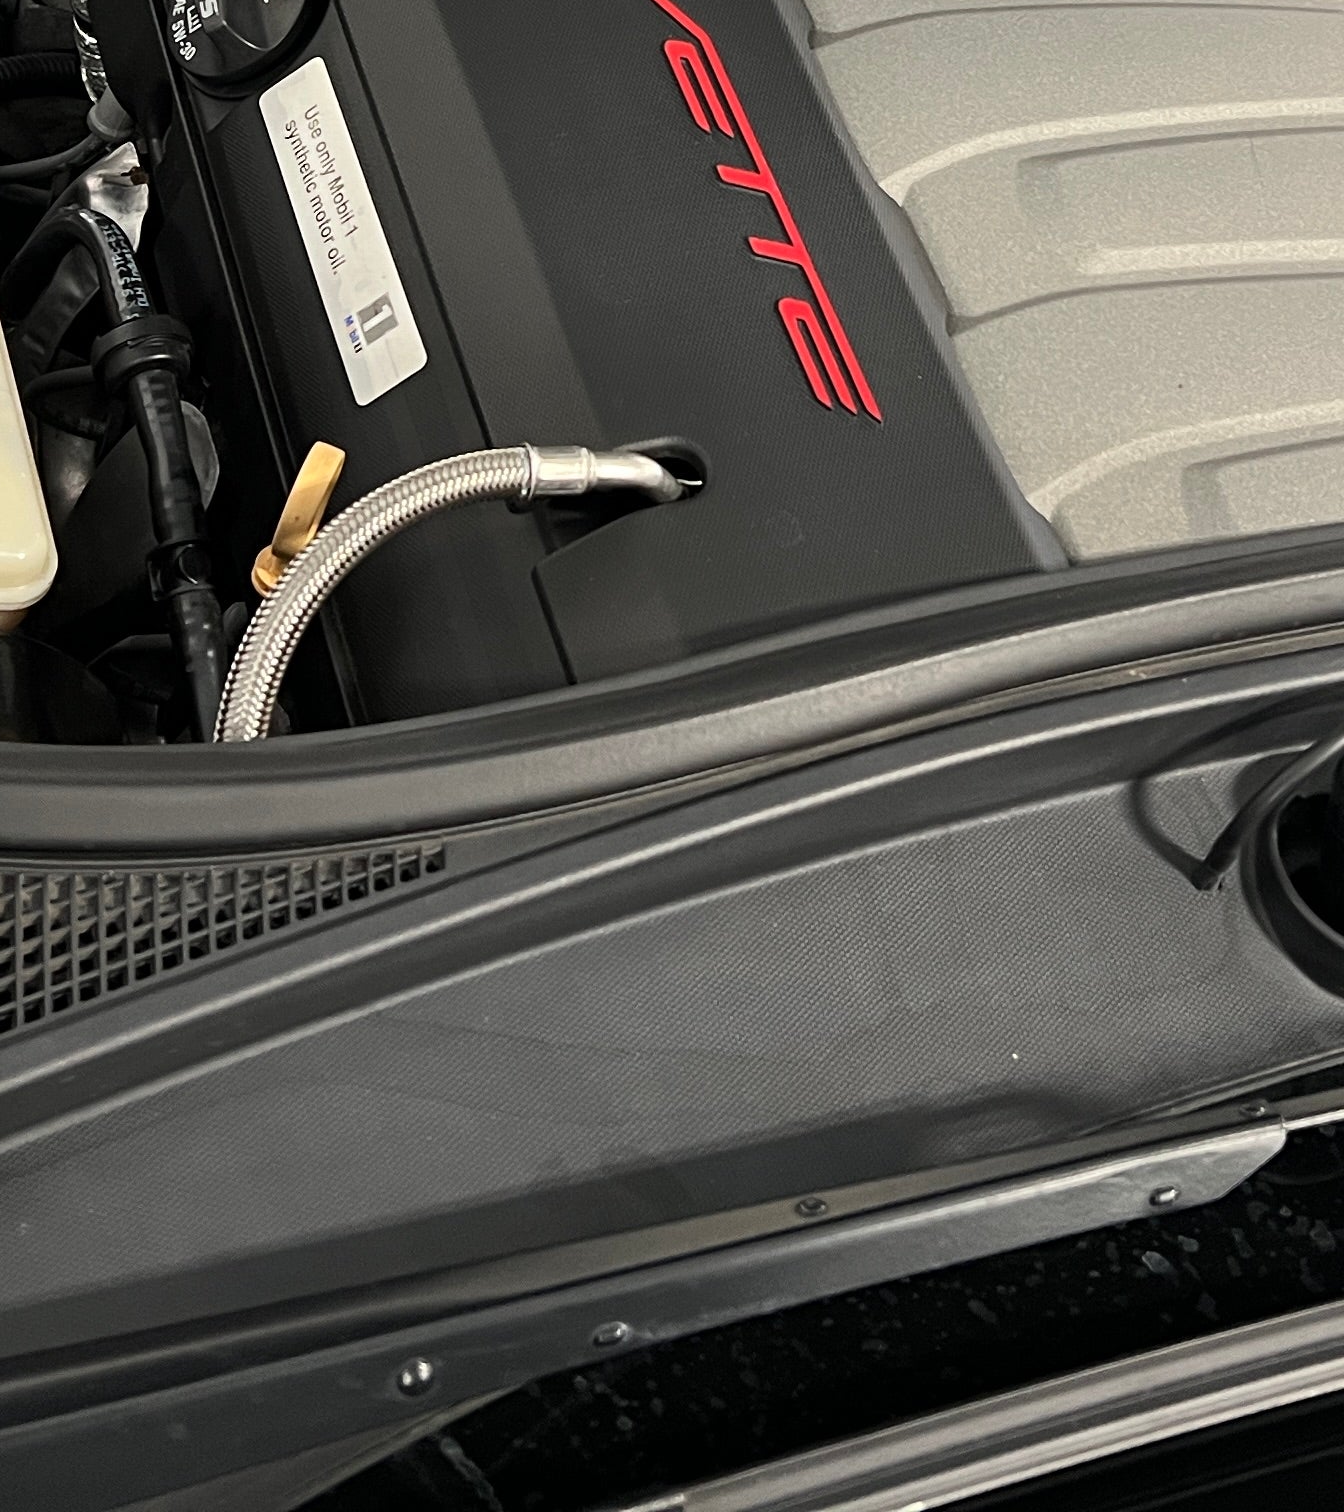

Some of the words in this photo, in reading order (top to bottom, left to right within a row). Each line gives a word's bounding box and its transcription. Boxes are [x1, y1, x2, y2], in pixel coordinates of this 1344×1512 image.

[171, 19, 197, 61] 5W-30
[284, 119, 317, 194] synthetic
[309, 194, 335, 244] motor
[327, 247, 347, 276] oil.
[304, 103, 323, 139] Use
[315, 141, 337, 176] only
[327, 175, 355, 226] Mobil
[344, 225, 359, 238] 1
[344, 314, 360, 344] Mbil
